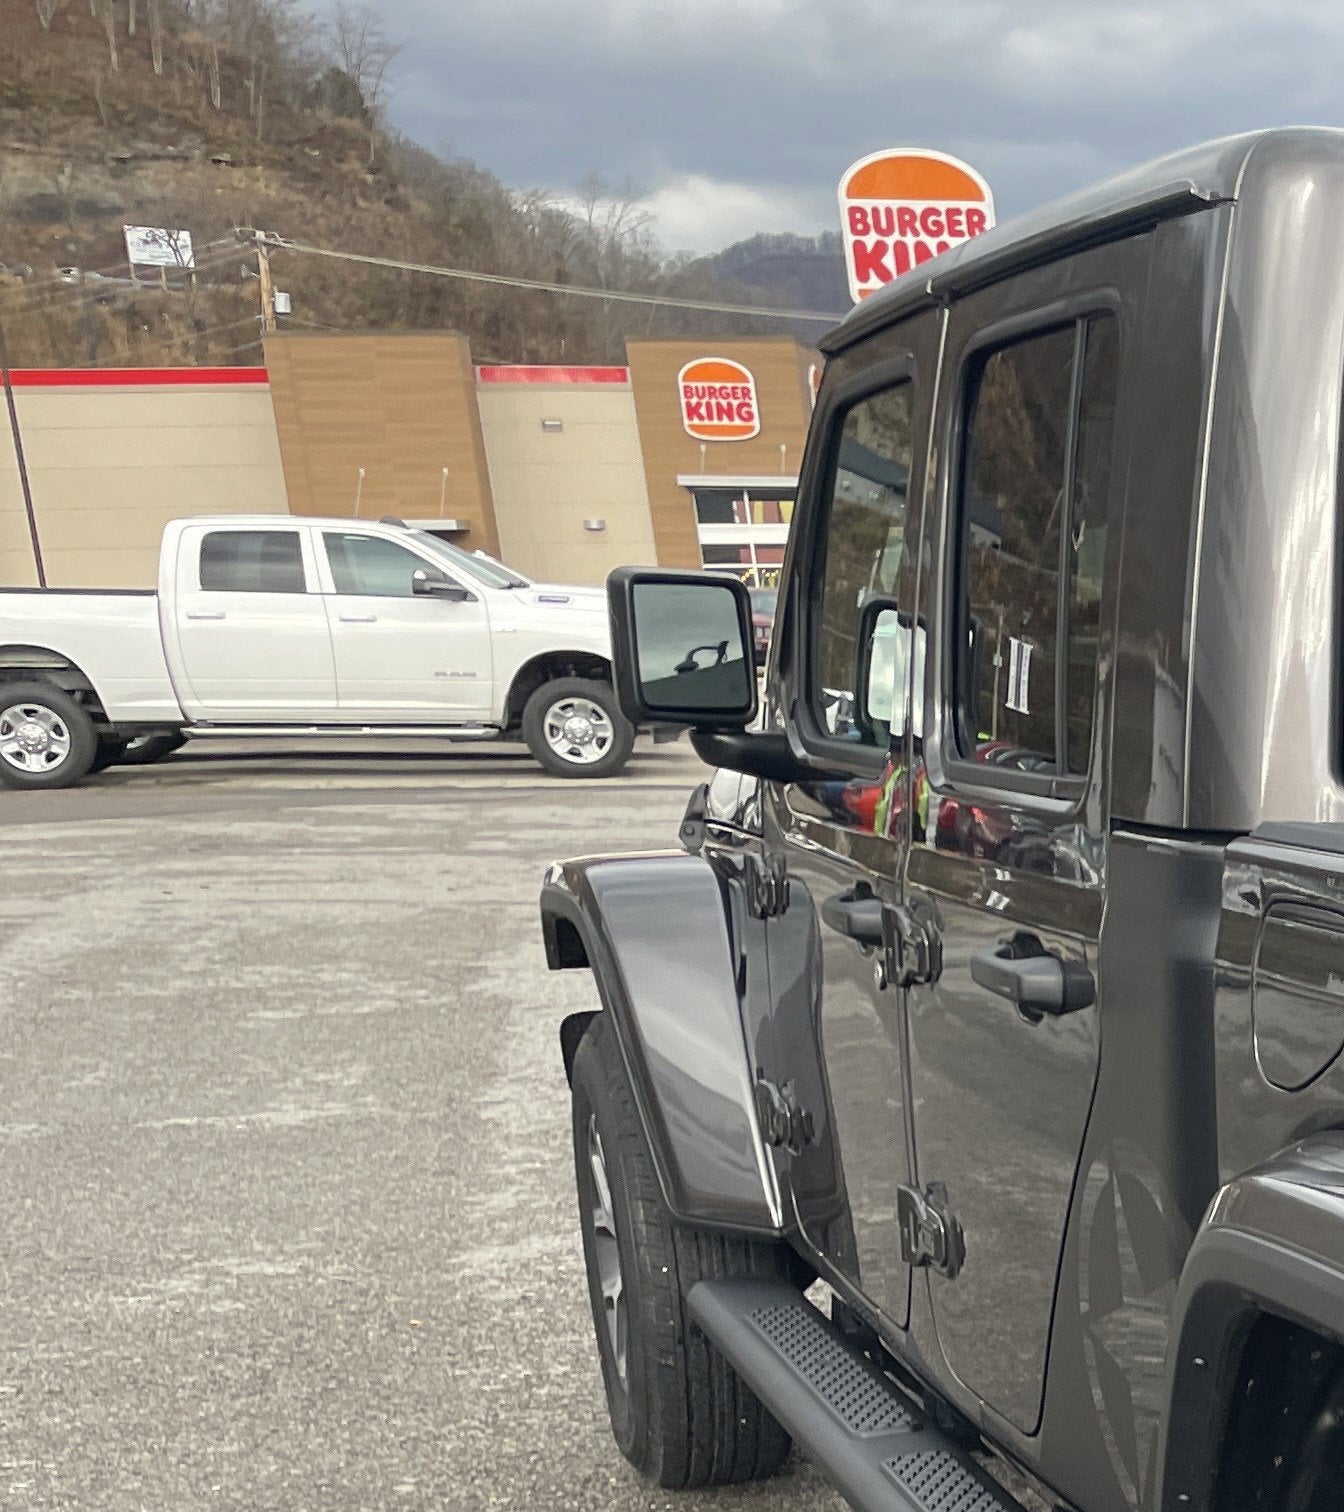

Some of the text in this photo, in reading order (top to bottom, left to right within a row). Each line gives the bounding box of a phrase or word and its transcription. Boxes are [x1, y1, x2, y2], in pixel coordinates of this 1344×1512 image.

[848, 205, 987, 239] BURGER
[683, 385, 752, 400] BURGER
[685, 401, 754, 422] KING
